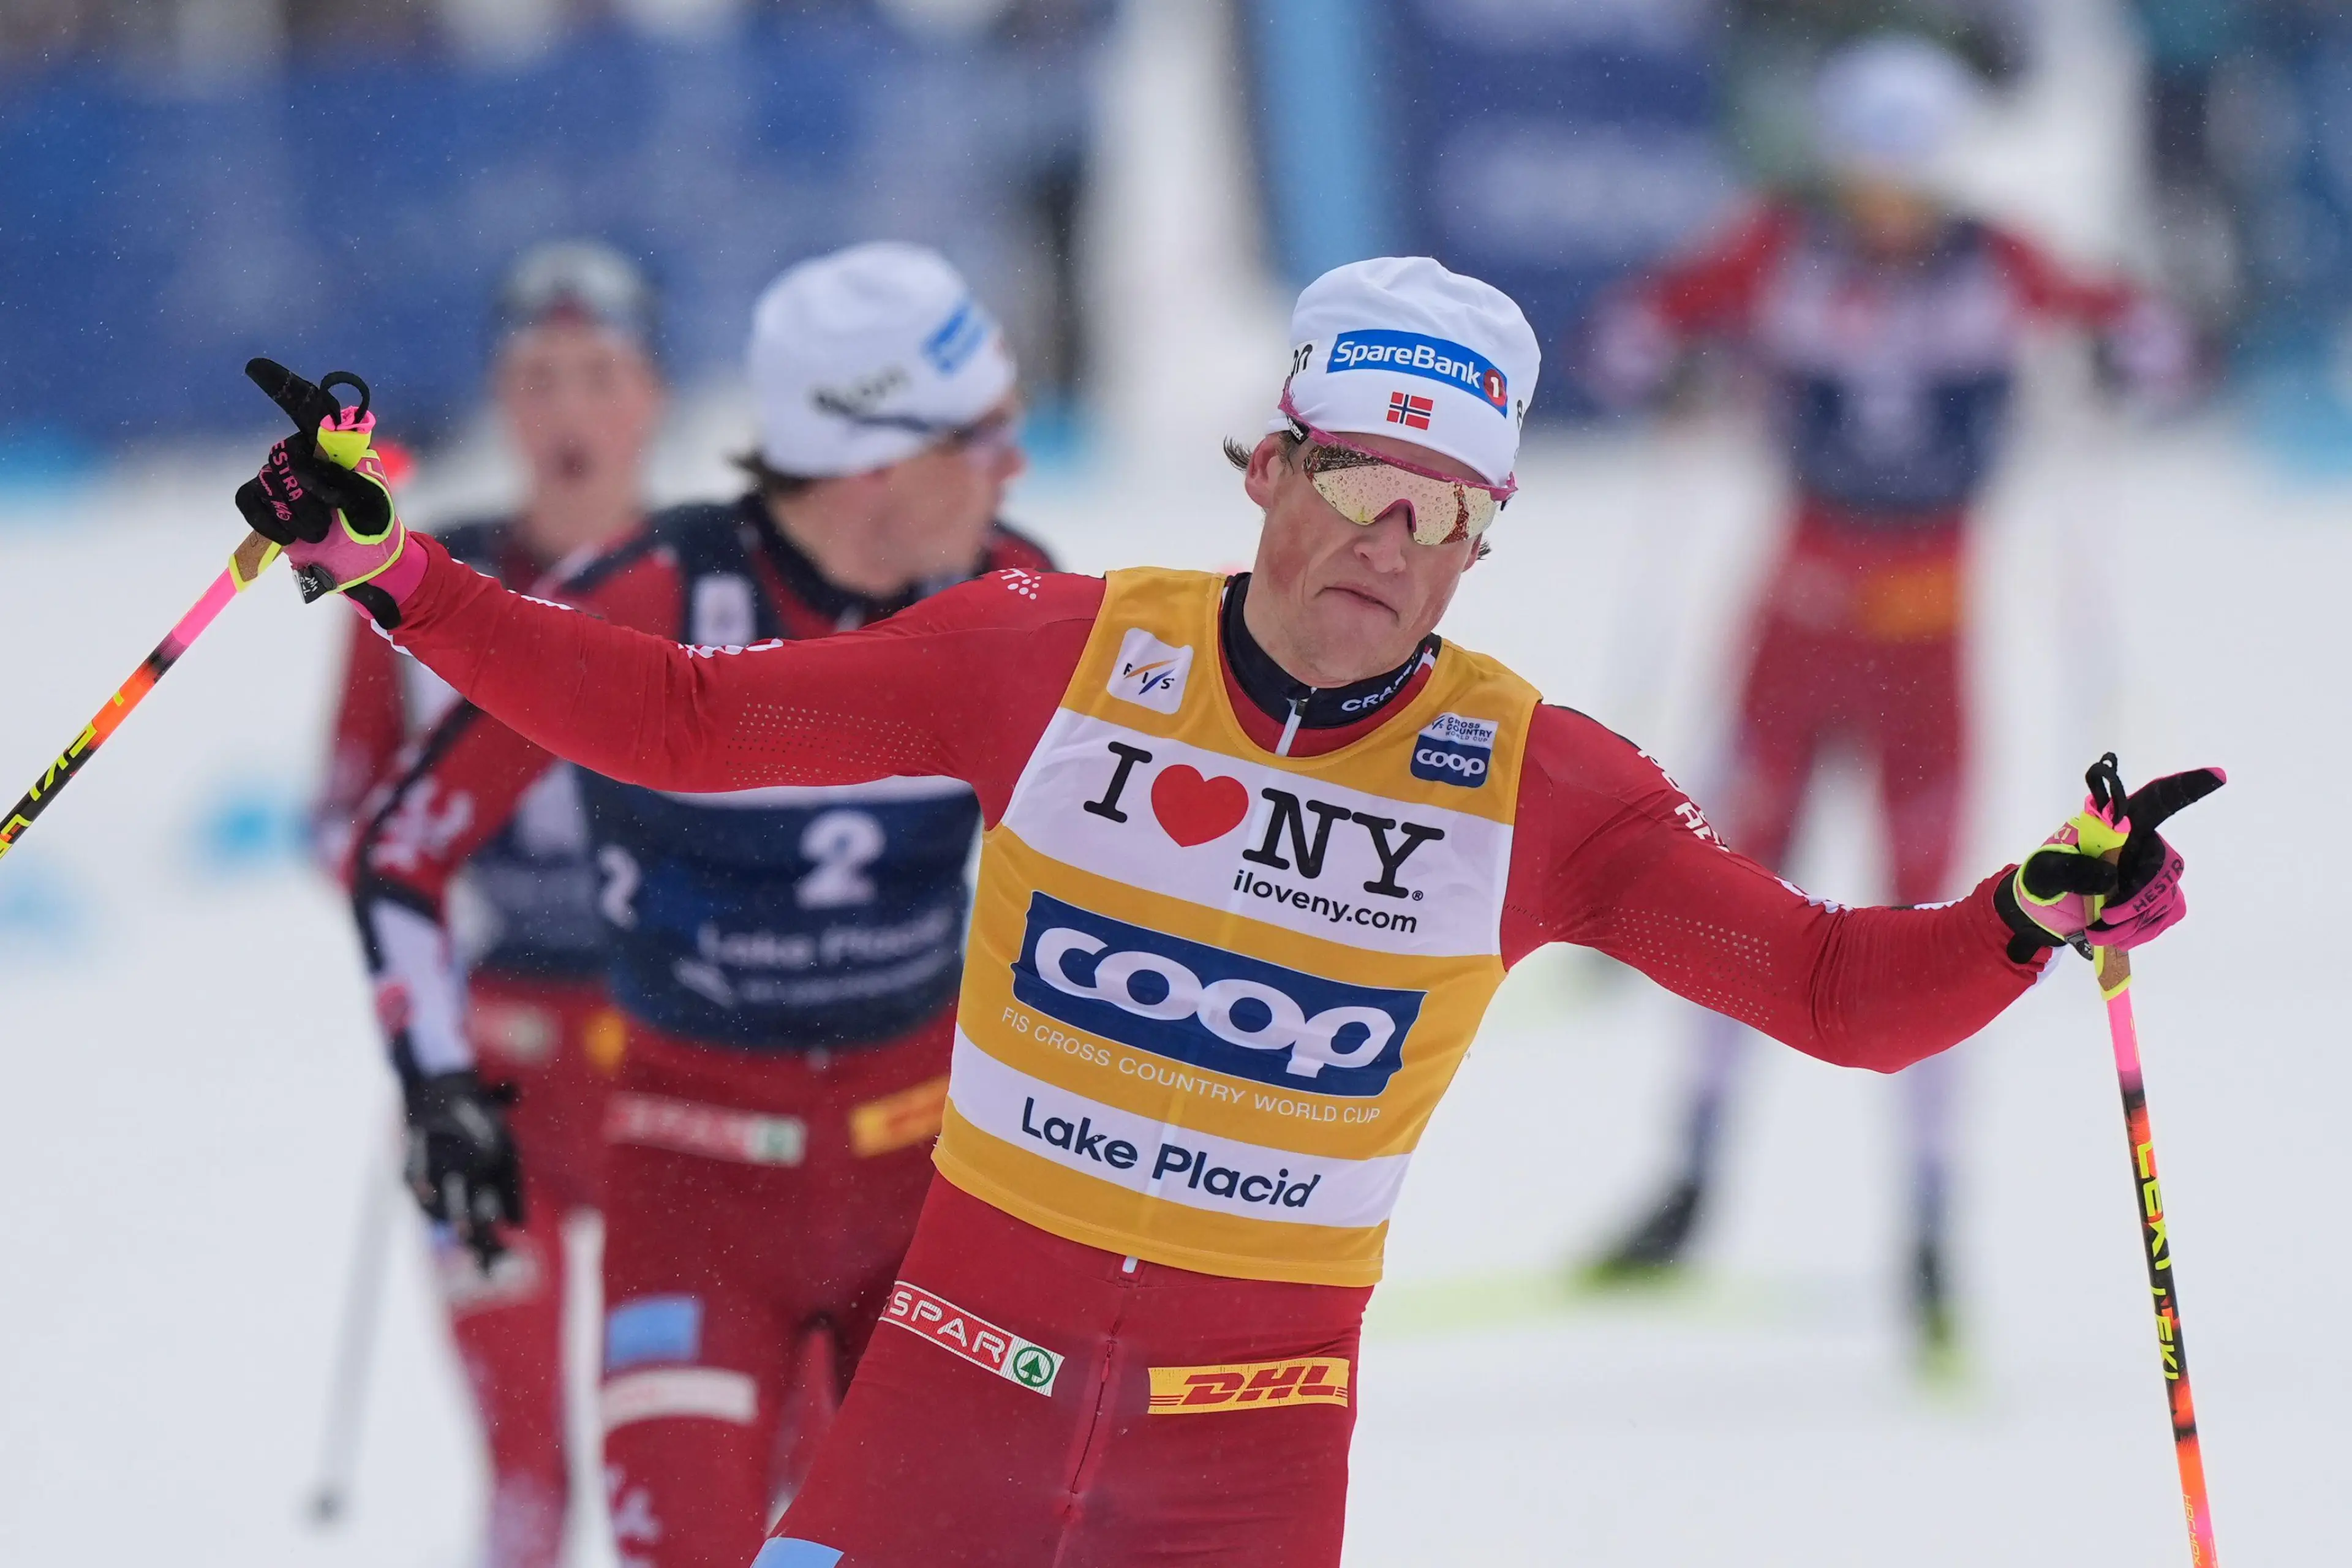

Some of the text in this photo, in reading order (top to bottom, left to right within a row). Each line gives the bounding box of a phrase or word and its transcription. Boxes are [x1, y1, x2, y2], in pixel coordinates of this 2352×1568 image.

[1333, 341, 1480, 390] SpareBank
[1123, 662, 1176, 690] FIS
[1445, 731, 1470, 741] WORLD
[1446, 723, 1493, 738] COUNTRY
[1447, 717, 1480, 729] CROSS
[1083, 741, 1153, 823] I
[1415, 748, 1486, 777] coop
[797, 809, 886, 908] 2
[1233, 870, 1417, 934] iloveny.com
[1035, 927, 1396, 1079] coop
[1002, 1007, 1381, 1123] FIS CROSS COUNTRY WORLD CUP
[1022, 1097, 1139, 1170] Lake
[1152, 1143, 1321, 1208] Placid
[890, 1291, 1006, 1363] SPAR
[1180, 1365, 1336, 1406] DHL
